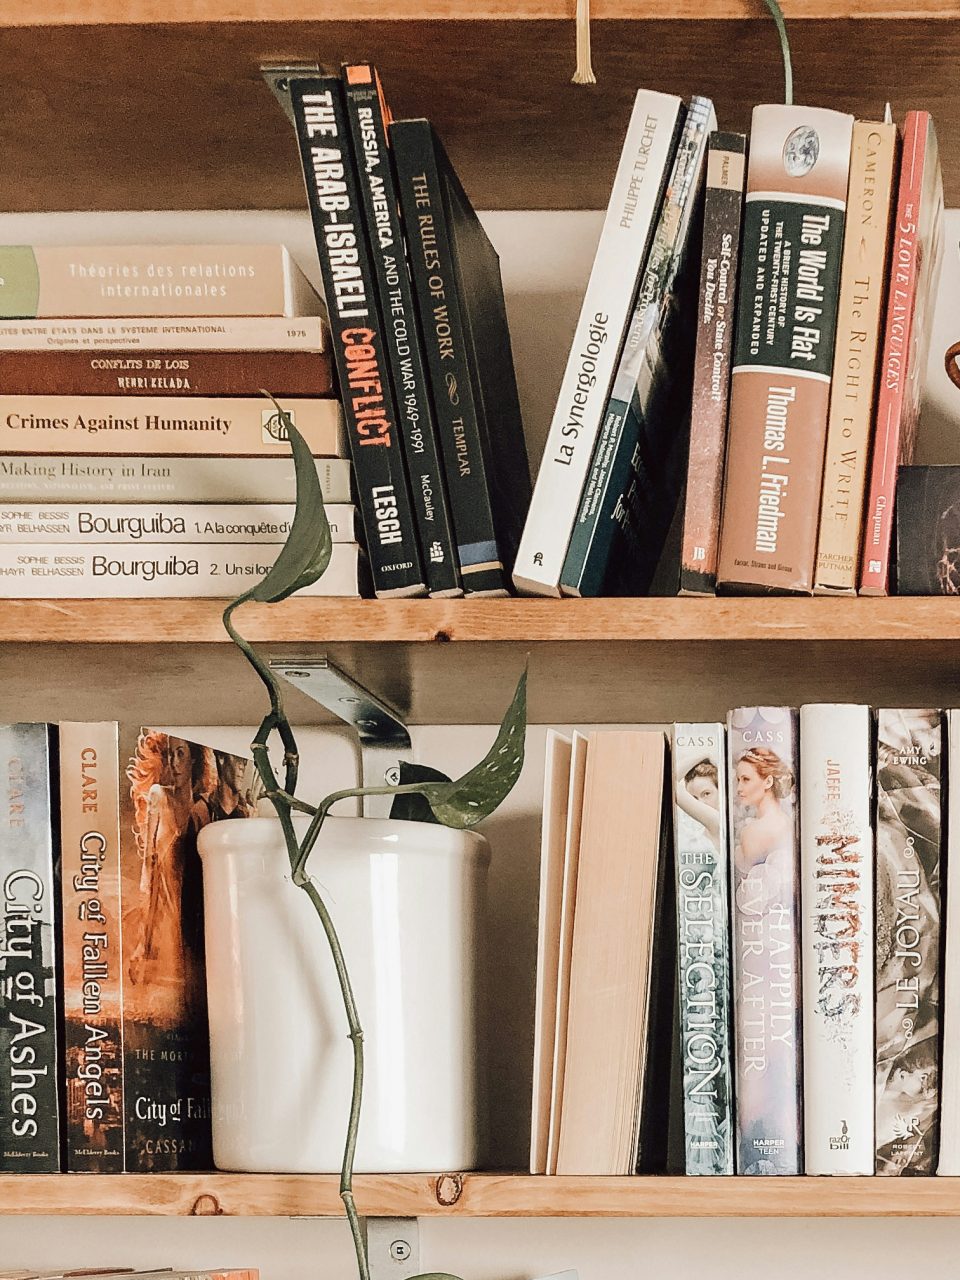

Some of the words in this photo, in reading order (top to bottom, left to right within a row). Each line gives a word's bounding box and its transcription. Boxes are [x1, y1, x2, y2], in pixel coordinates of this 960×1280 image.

[302, 91, 336, 137] THE
[357, 107, 379, 173] RUSSIA,
[411, 173, 428, 209] THE
[619, 175, 643, 229] PHILIPPE
[632, 114, 658, 172] TURCHET
[311, 147, 369, 318] ARAB-ISRAELI
[369, 175, 393, 249] AMERICA
[416, 214, 441, 270] RULES
[756, 208, 769, 264] UPDATED
[799, 214, 829, 246] The
[69, 264, 143, 278] Théories
[181, 264, 256, 277] relations
[101, 282, 227, 298] internationales
[717, 233, 732, 304] Self-Control
[795, 250, 826, 301] World
[894, 238, 913, 284] LOVE
[394, 318, 412, 356] COLD
[432, 305, 455, 360] WORK
[790, 326, 819, 361] Flat
[794, 305, 818, 323] Is
[886, 287, 911, 393] LANGUAGES
[341, 327, 391, 449] CONFLICT
[400, 359, 416, 391] WAR
[559, 311, 609, 440] Synergologie
[6, 413, 69, 429] Crimes
[74, 416, 139, 432] Against
[145, 415, 232, 434] Humanity
[452, 416, 471, 477] TEMPLAR
[764, 385, 796, 451] Thomas
[61, 463, 115, 479] History
[140, 465, 171, 477] Iran
[420, 474, 437, 521] McCauley
[78, 513, 186, 538] Bourguiba
[371, 485, 403, 545] LESCH
[755, 472, 788, 552] Friedman
[872, 495, 887, 546] Chapman
[92, 556, 199, 580] Bourguiba
[82, 748, 98, 813] CLARE
[74, 830, 106, 892] City
[0, 870, 43, 958] City
[740, 876, 765, 961] EVER
[813, 835, 864, 1020] MINDERS
[895, 869, 923, 968] JOYAU
[83, 933, 106, 1013] Fallen
[681, 868, 722, 1098] SELECTION
[768, 904, 792, 1048] HAPPILY
[896, 977, 919, 1009] LE
[743, 969, 766, 1077] AFTER
[9, 1013, 46, 1137] Ashes
[74, 1023, 108, 1119] Angels
